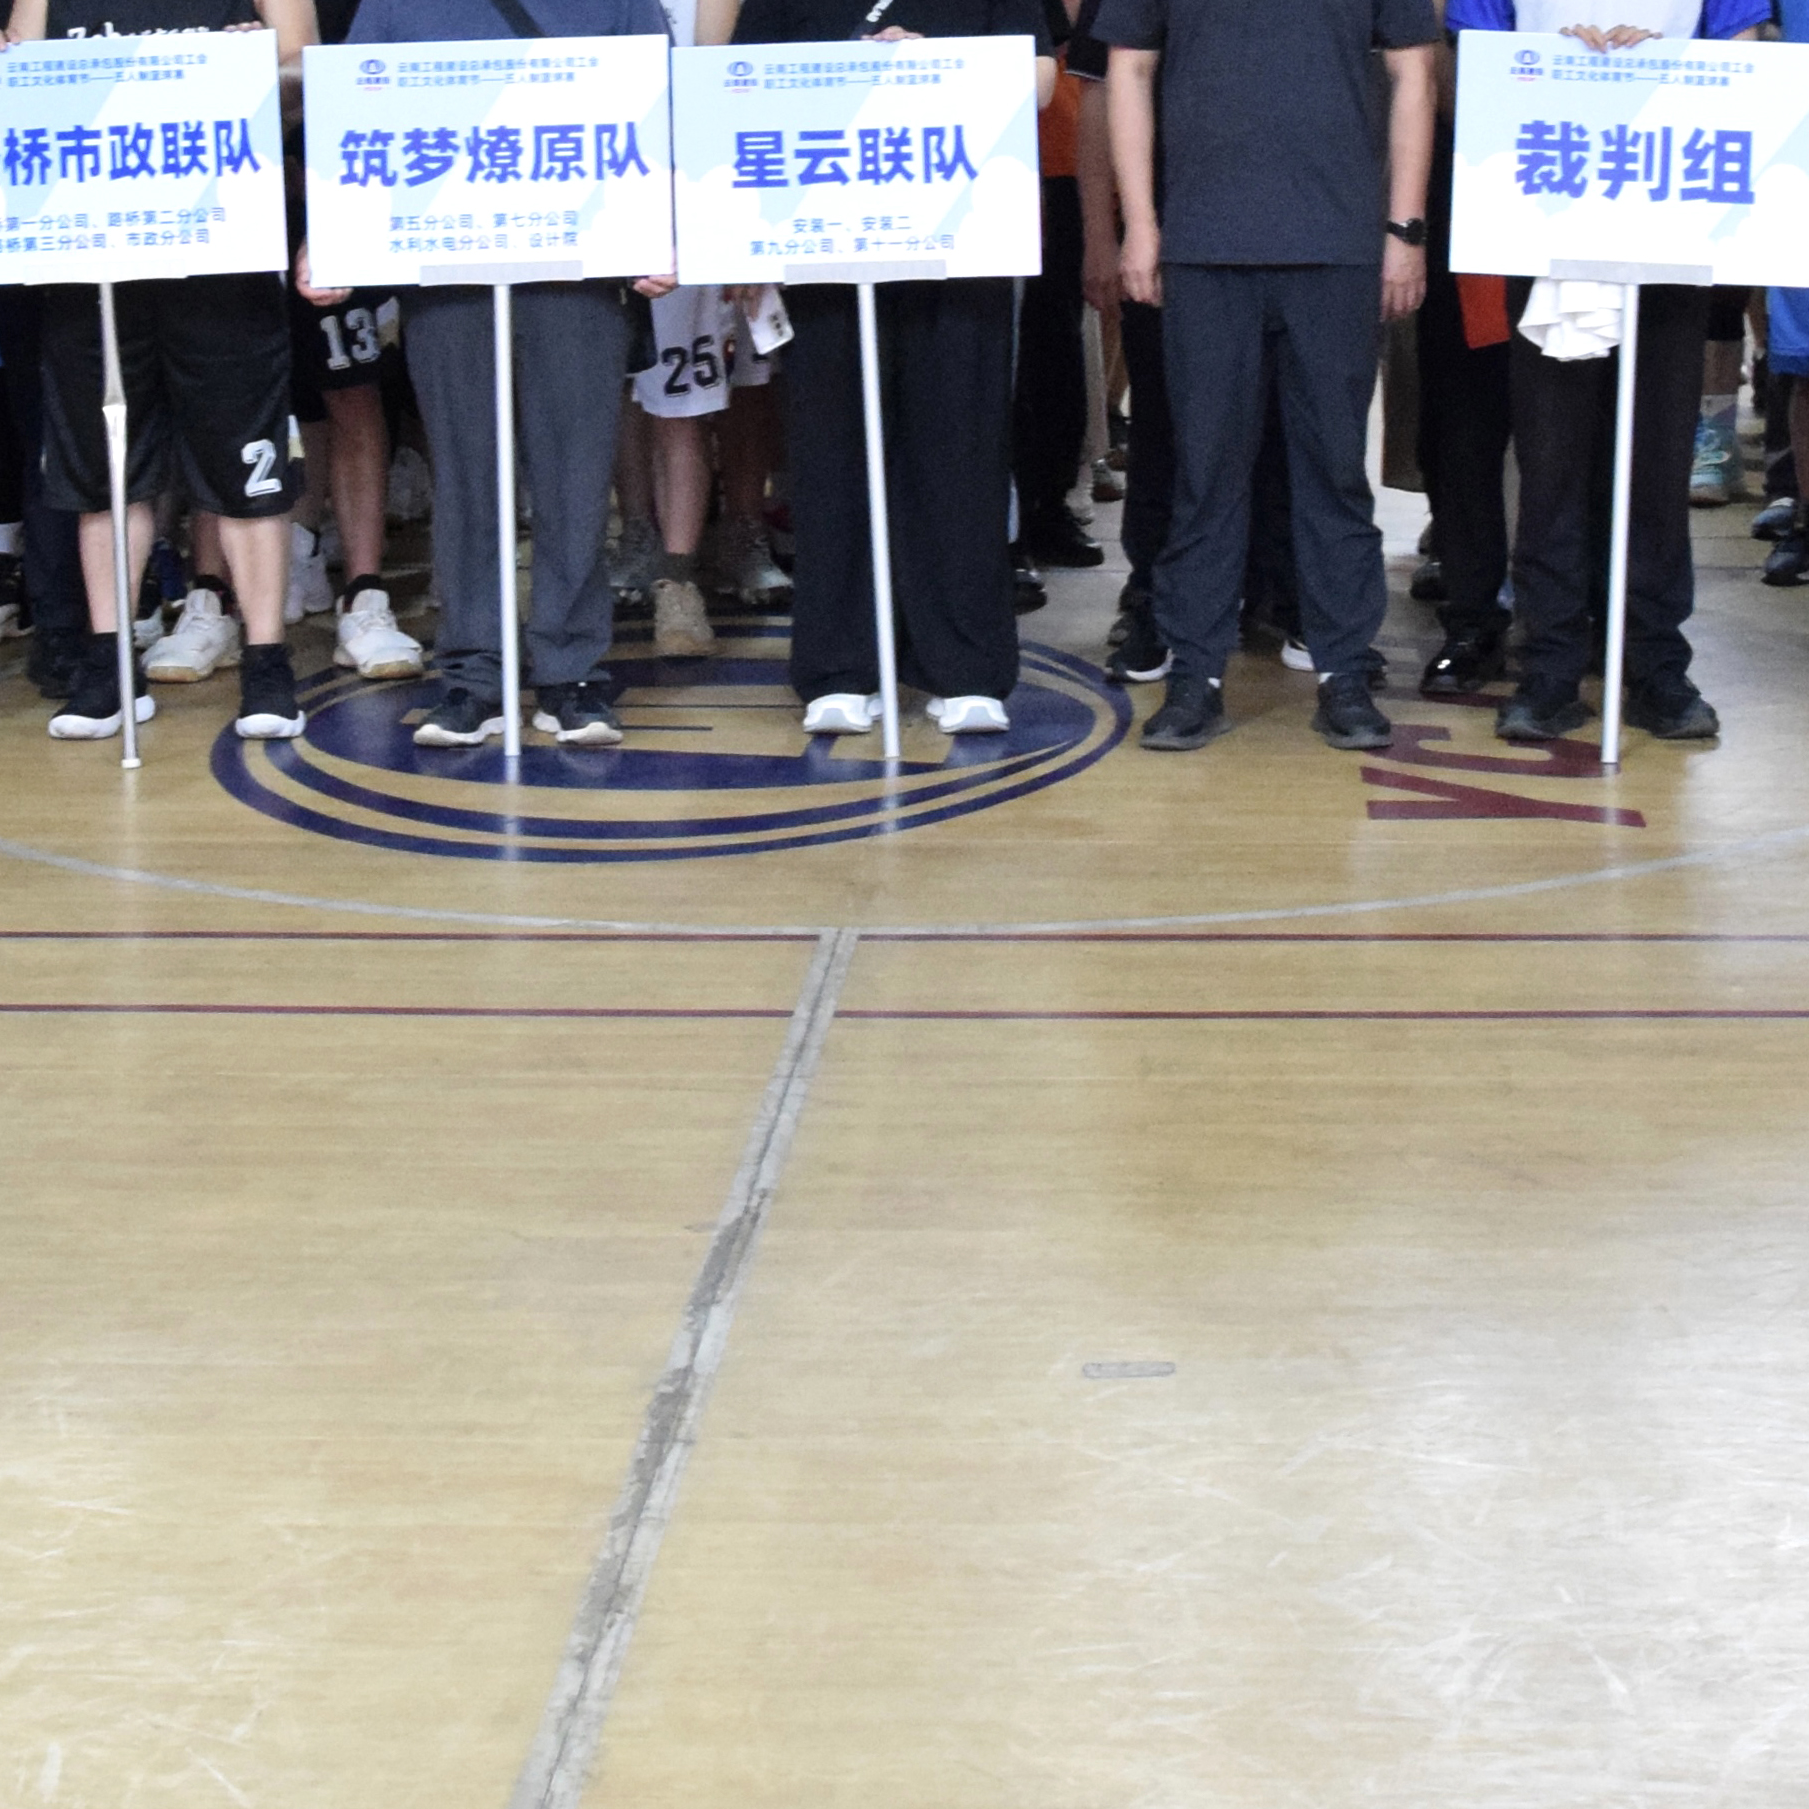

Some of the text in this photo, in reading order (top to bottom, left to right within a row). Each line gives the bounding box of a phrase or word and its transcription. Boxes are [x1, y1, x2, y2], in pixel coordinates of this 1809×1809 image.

[339, 121, 650, 189] 筑梦燎原队
[732, 124, 978, 189] 星云联队
[1515, 119, 1754, 205] 裁判组
[320, 308, 380, 371] 13
[661, 335, 722, 397] 25
[241, 438, 283, 498] 2
